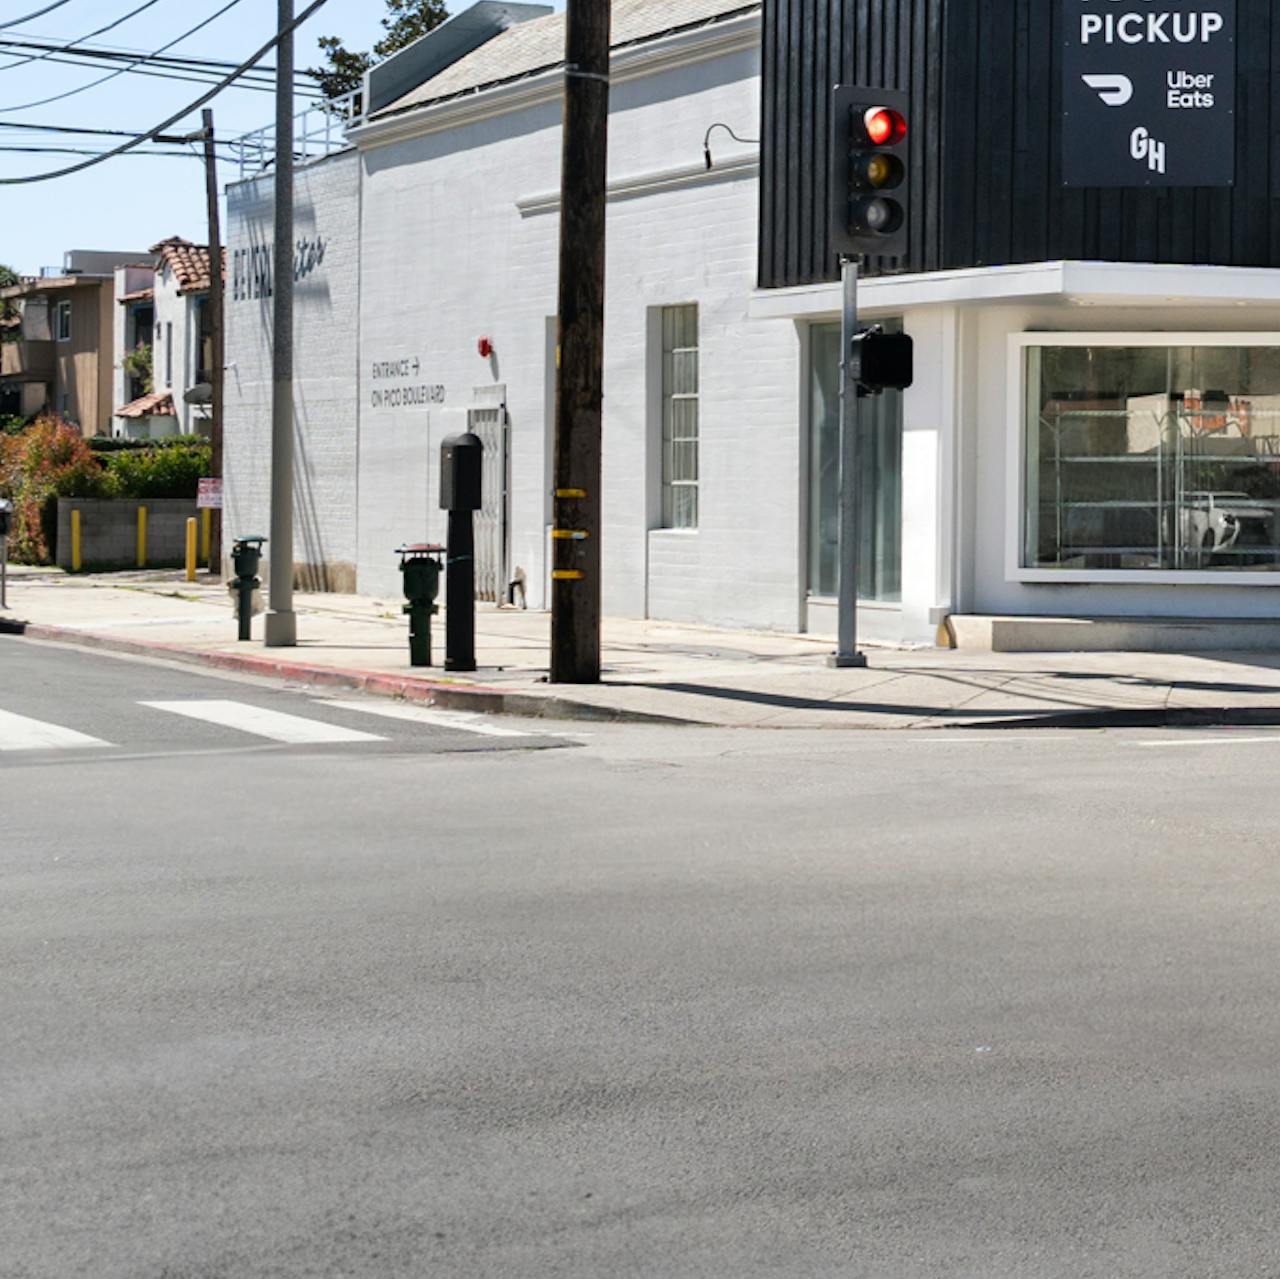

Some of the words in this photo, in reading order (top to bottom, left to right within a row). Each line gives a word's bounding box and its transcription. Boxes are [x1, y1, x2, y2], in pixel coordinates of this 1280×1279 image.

[1080, 12, 1223, 44] PICKUP
[1167, 70, 1215, 89] Uber
[1167, 89, 1214, 109] Eats
[1130, 126, 1165, 174] GH
[233, 246, 272, 301] BEVERL
[372, 359, 409, 379] ENTRANCE
[372, 390, 383, 407] ON
[384, 387, 402, 407] PICO
[402, 384, 445, 405] BOULEVARD
